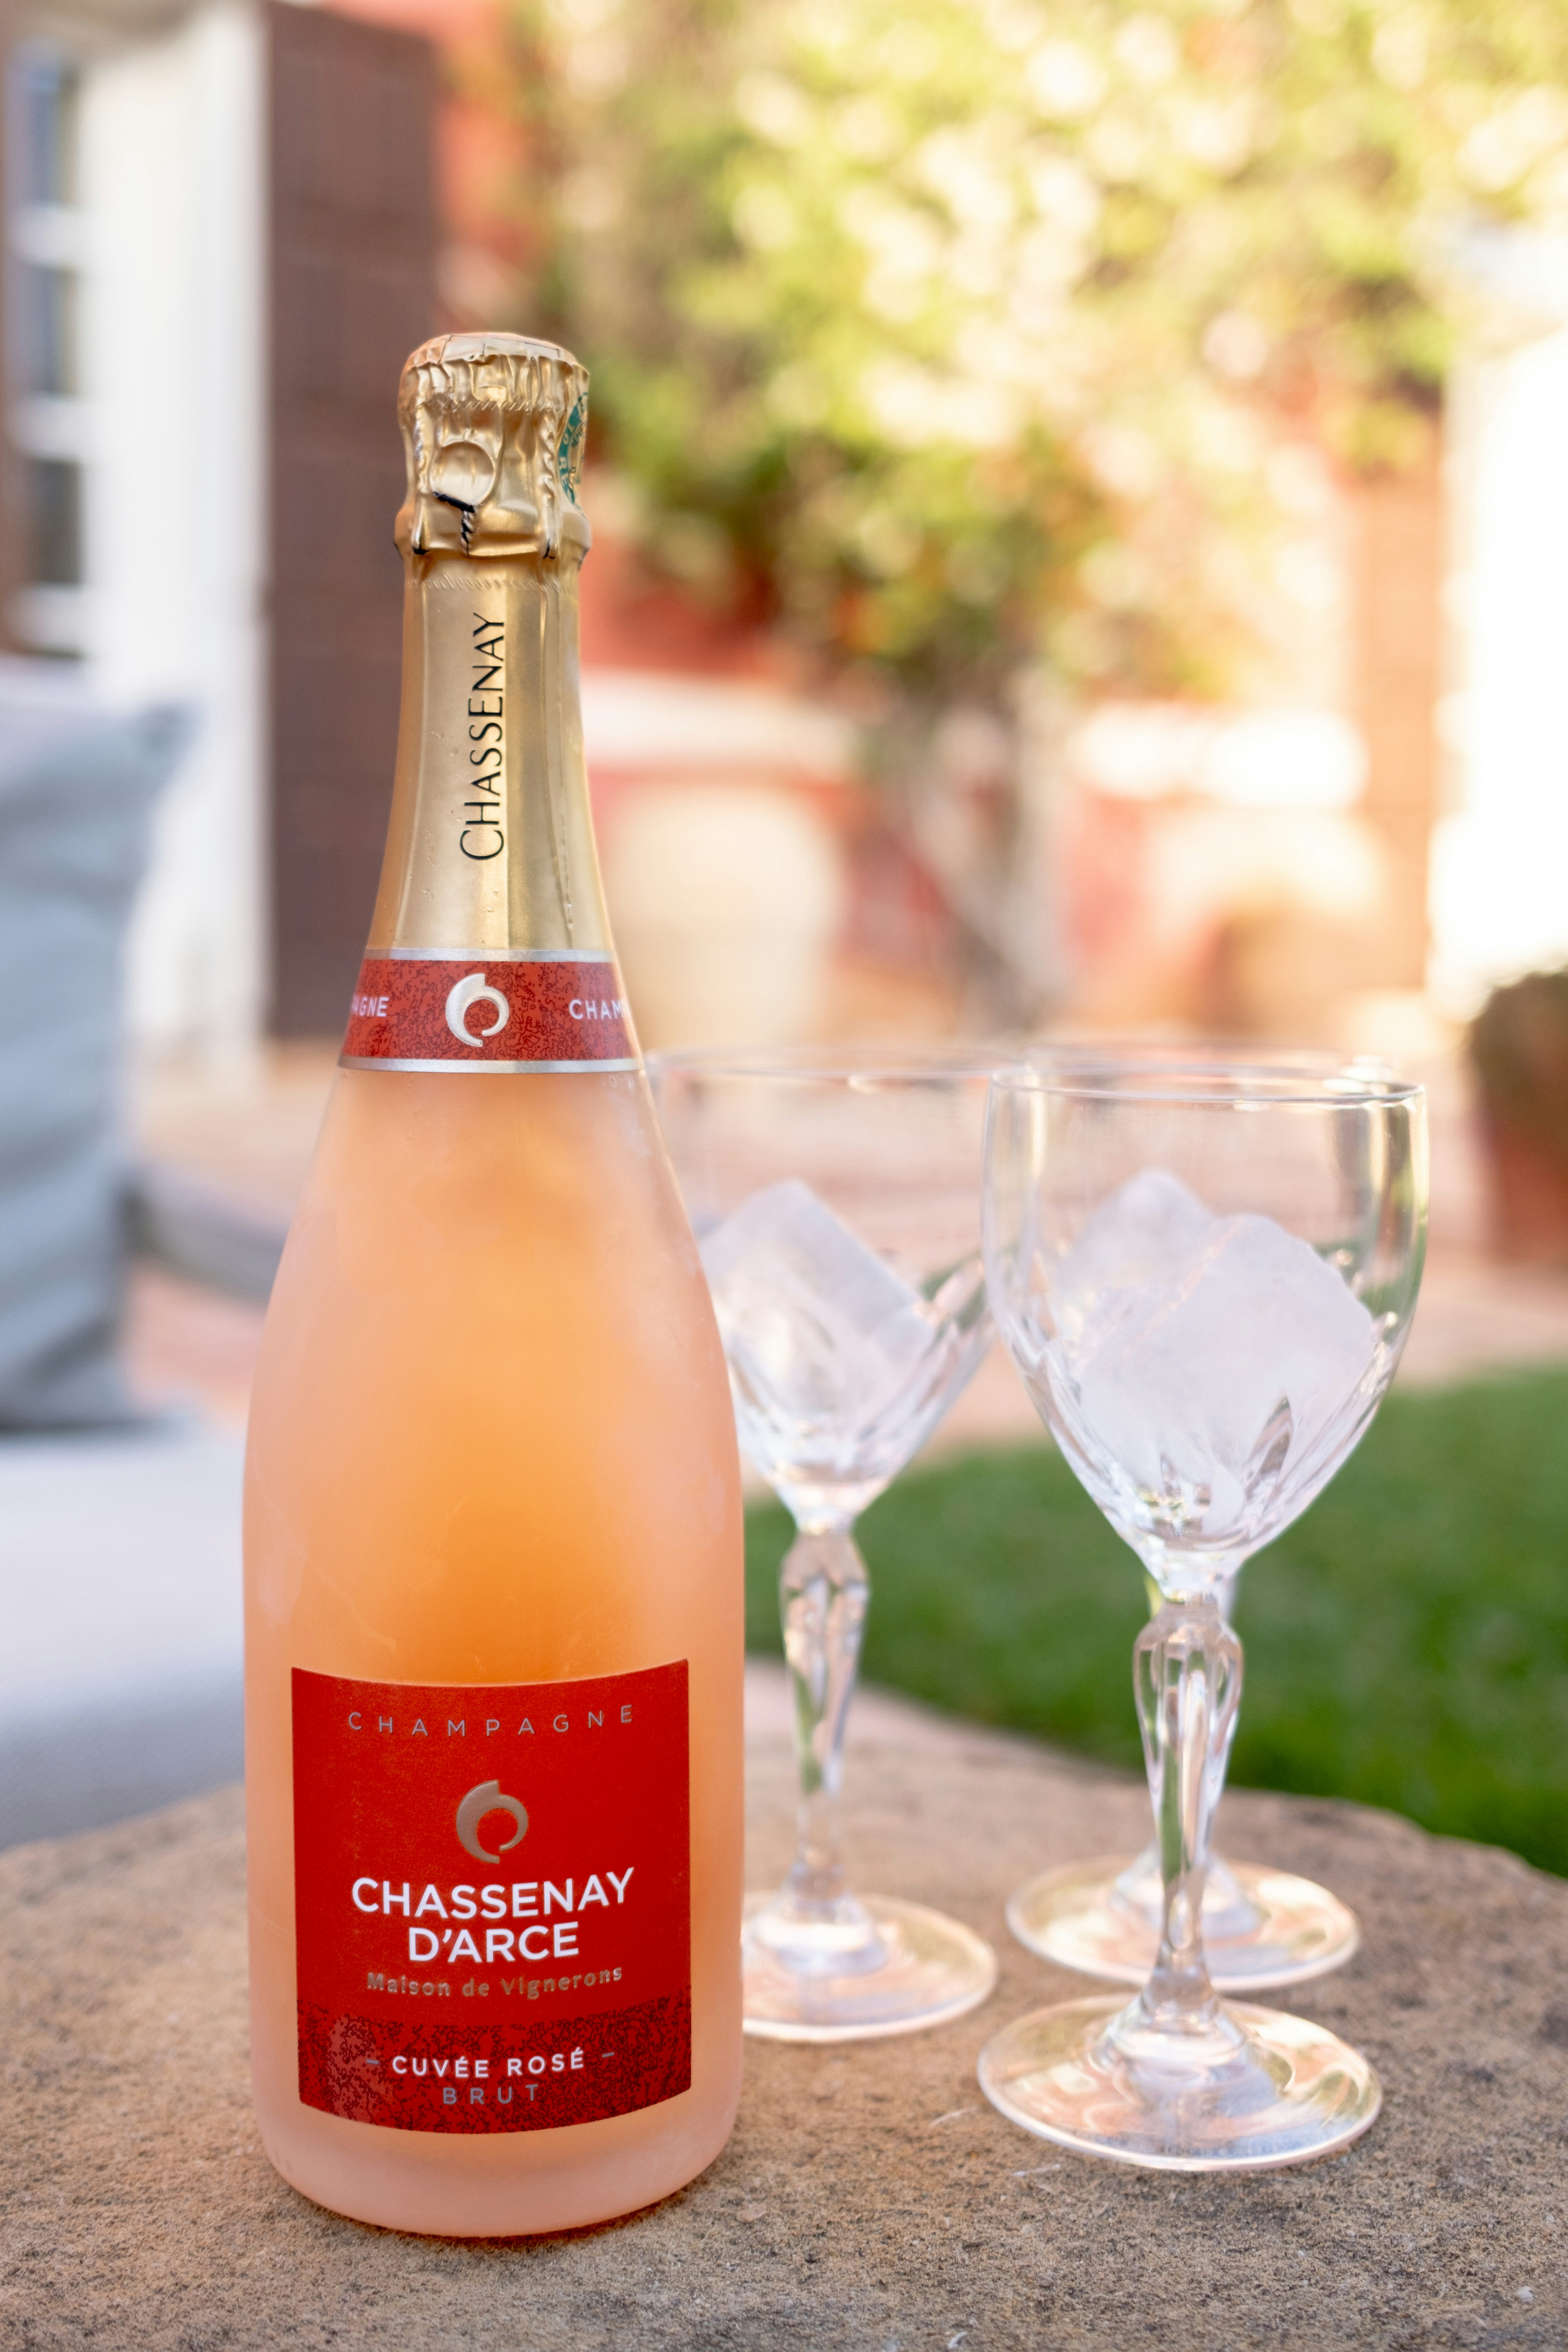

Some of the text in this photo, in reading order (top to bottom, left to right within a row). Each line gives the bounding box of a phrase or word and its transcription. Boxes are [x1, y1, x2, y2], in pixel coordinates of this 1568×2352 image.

[460, 612, 504, 860] CHASSENAY
[569, 999, 626, 1020] CHAM
[348, 1704, 632, 1737] CHAMPAGNE
[352, 1867, 634, 1919] CHASSENAY
[409, 1921, 579, 1963] D’ARCE
[367, 1967, 623, 2000] Maison de Vignerons
[392, 2047, 584, 2078] CUVÉE ROSÉ
[443, 2084, 539, 2105] BRUT
